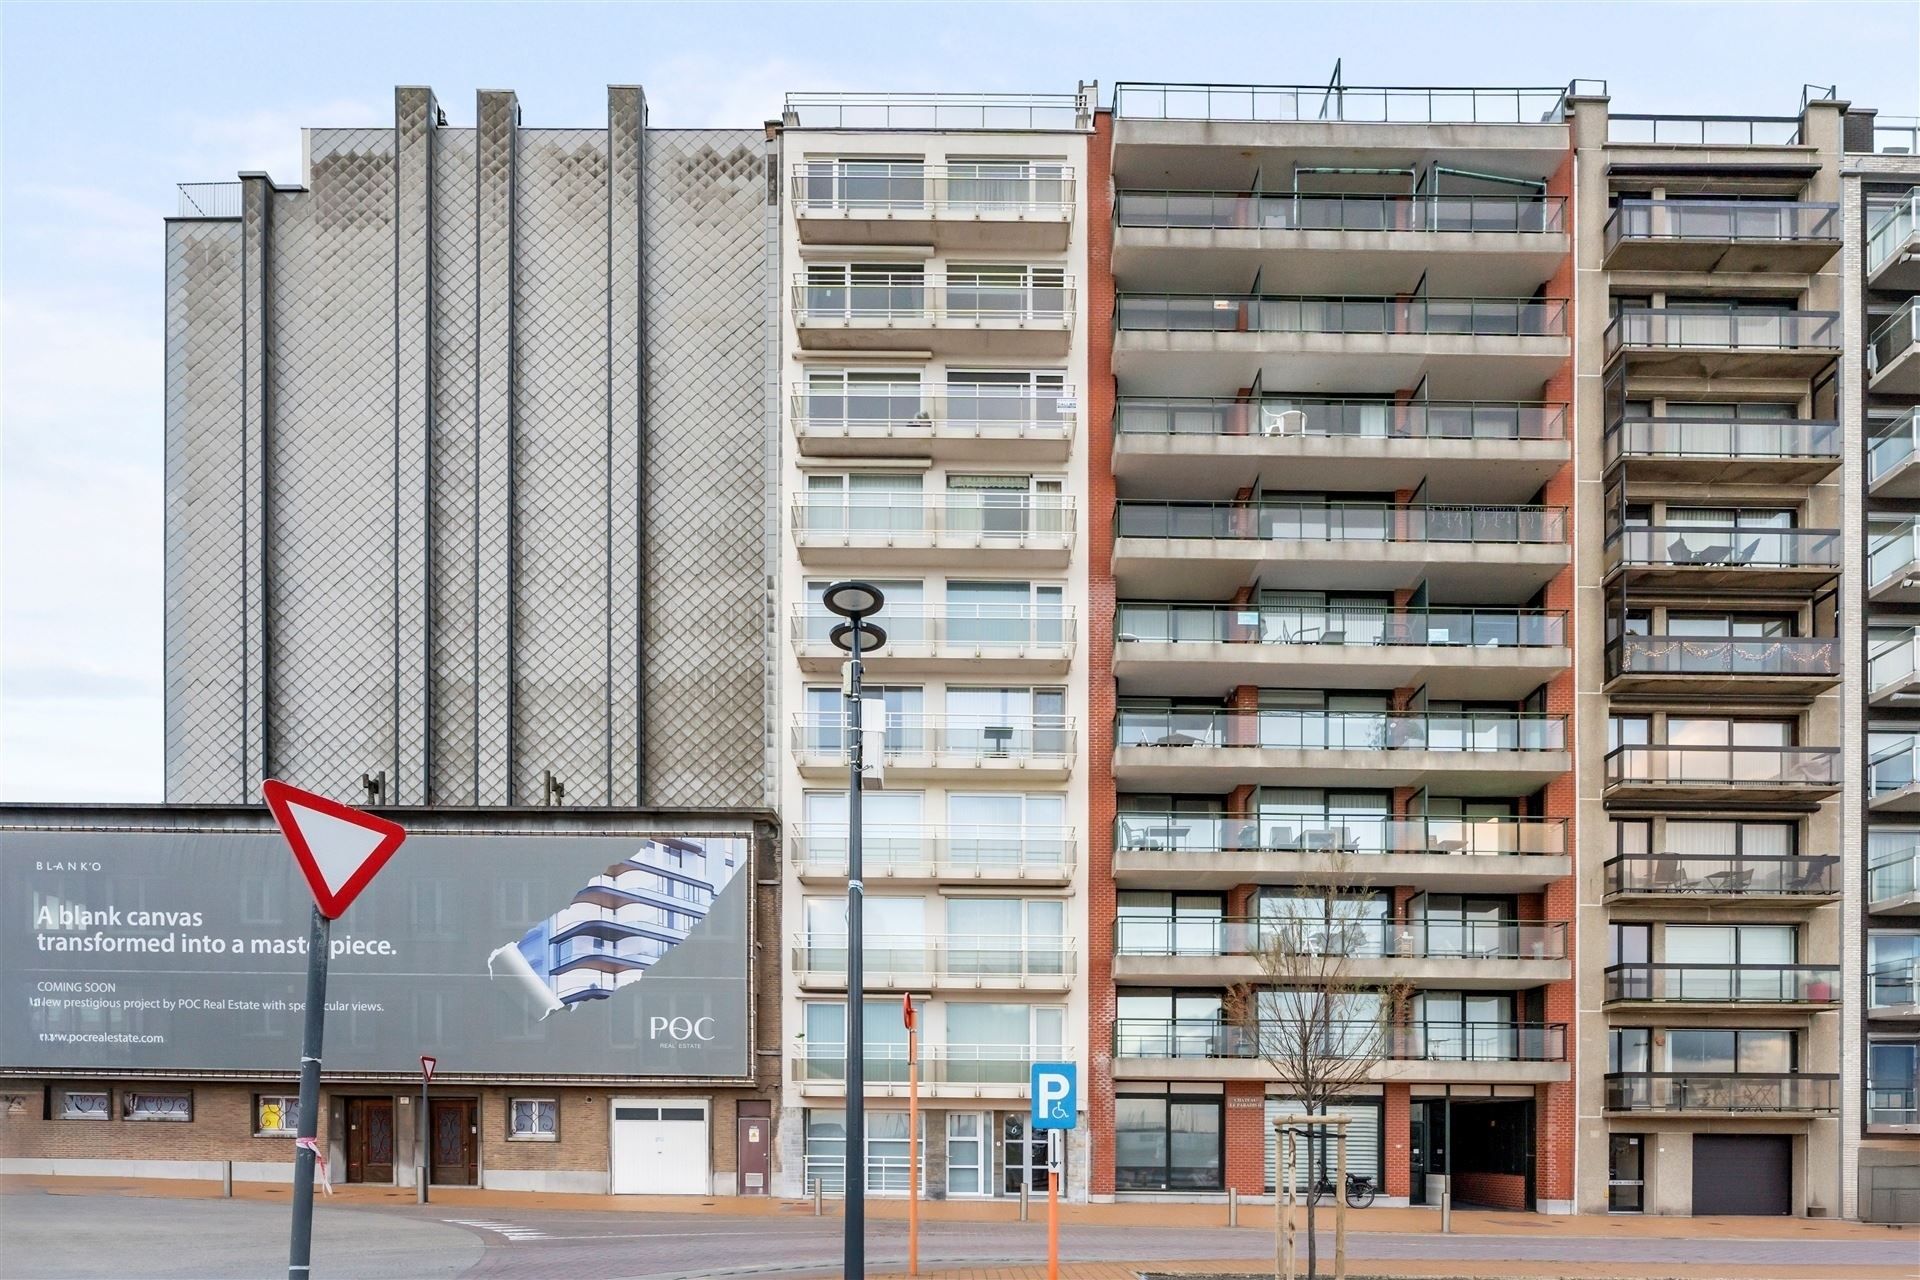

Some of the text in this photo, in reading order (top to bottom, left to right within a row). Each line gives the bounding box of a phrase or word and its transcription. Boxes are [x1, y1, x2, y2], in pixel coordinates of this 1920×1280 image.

[37, 905, 203, 927] A blank canvas
[37, 932, 397, 960] transformed into a mastpiece.
[37, 981, 116, 993] COMING SOON
[63, 997, 121, 1010] prestigious
[123, 998, 161, 1011] project
[162, 998, 176, 1012] by
[178, 999, 201, 1010] POC
[203, 999, 226, 1010] Real
[228, 999, 260, 1010] Estate
[262, 1000, 286, 1011] with
[288, 1001, 349, 1012] specular
[351, 1002, 385, 1012] views.
[40, 1031, 164, 1044] w.pocrealestate.com
[650, 1016, 716, 1041] POC
[1038, 1073, 1070, 1119] P
[1011, 1125, 1018, 1134] 6
